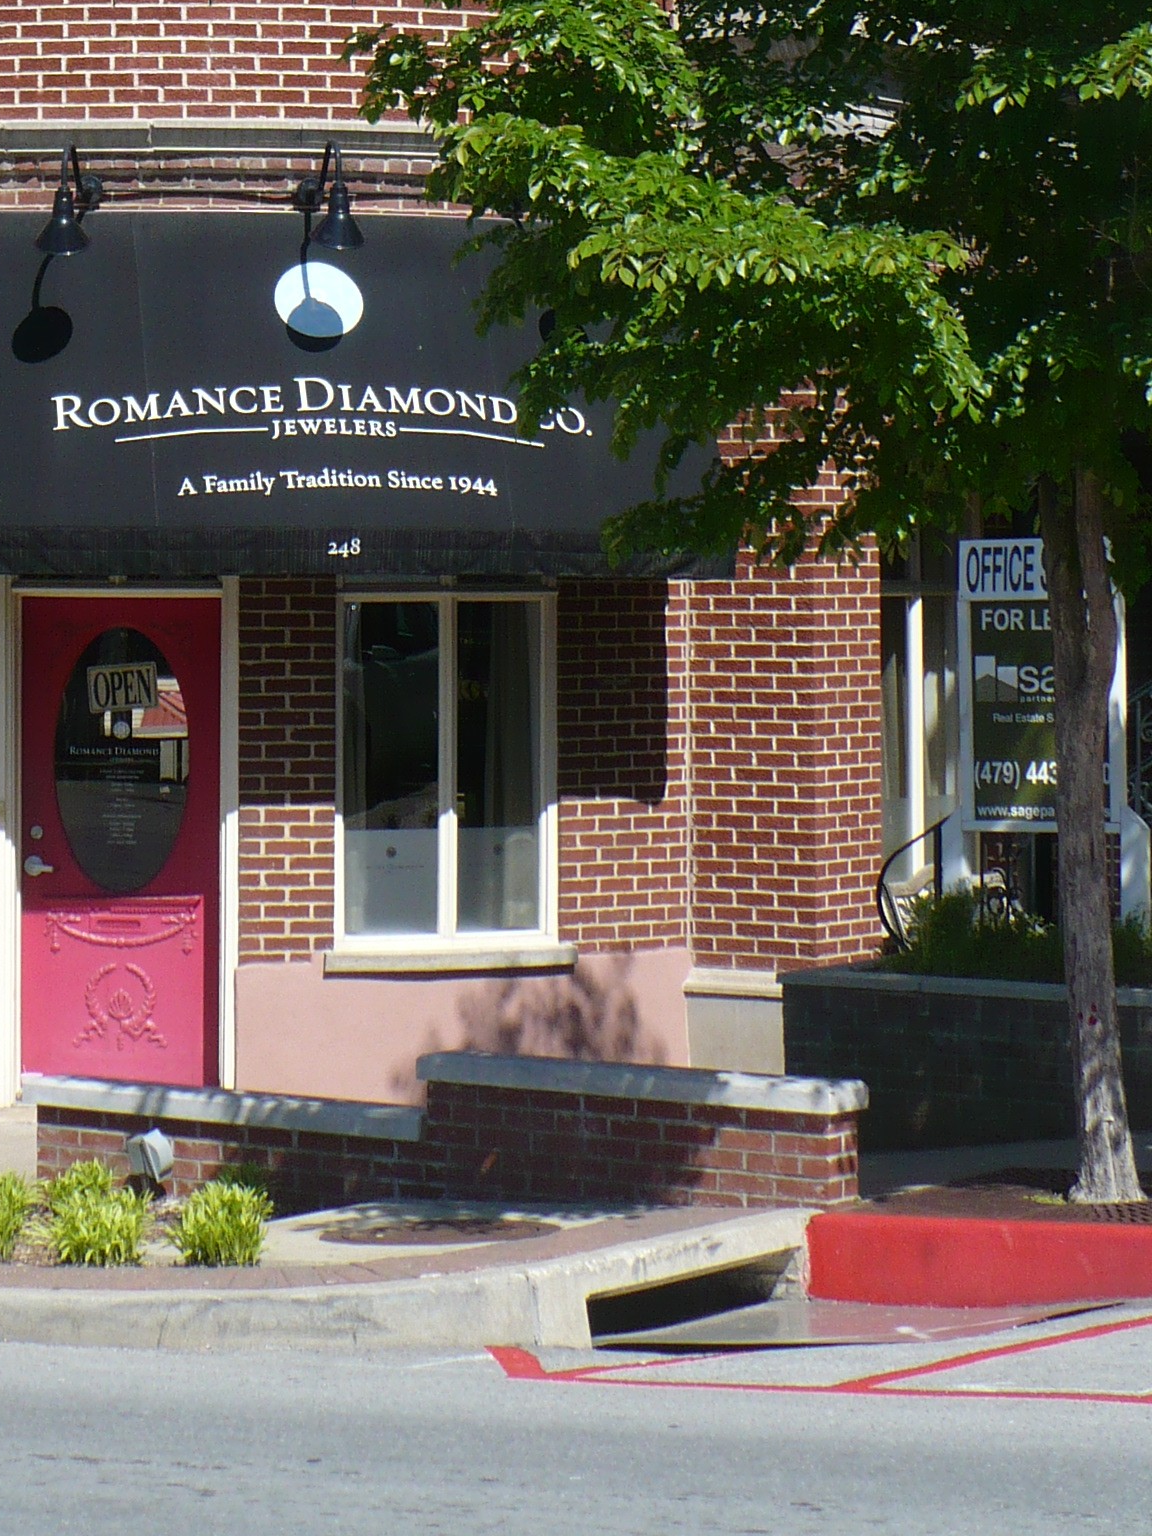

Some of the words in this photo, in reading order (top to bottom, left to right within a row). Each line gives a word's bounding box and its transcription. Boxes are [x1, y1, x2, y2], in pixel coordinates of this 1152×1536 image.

[51, 385, 284, 431] ROMANCE
[293, 376, 517, 425] DIAMOND
[272, 417, 397, 440] JEWELERS
[177, 477, 197, 496] A
[203, 471, 275, 496] Family
[279, 467, 382, 490] Tradition
[388, 470, 443, 491] Since
[449, 475, 498, 497] 1944
[327, 537, 361, 558] 248
[966, 545, 1035, 592] OFFICE
[981, 608, 1025, 631] FOR
[93, 669, 153, 708] OPEN
[993, 713, 1013, 723] Real
[1015, 712, 1045, 723] Estate
[975, 761, 1020, 790] (479)
